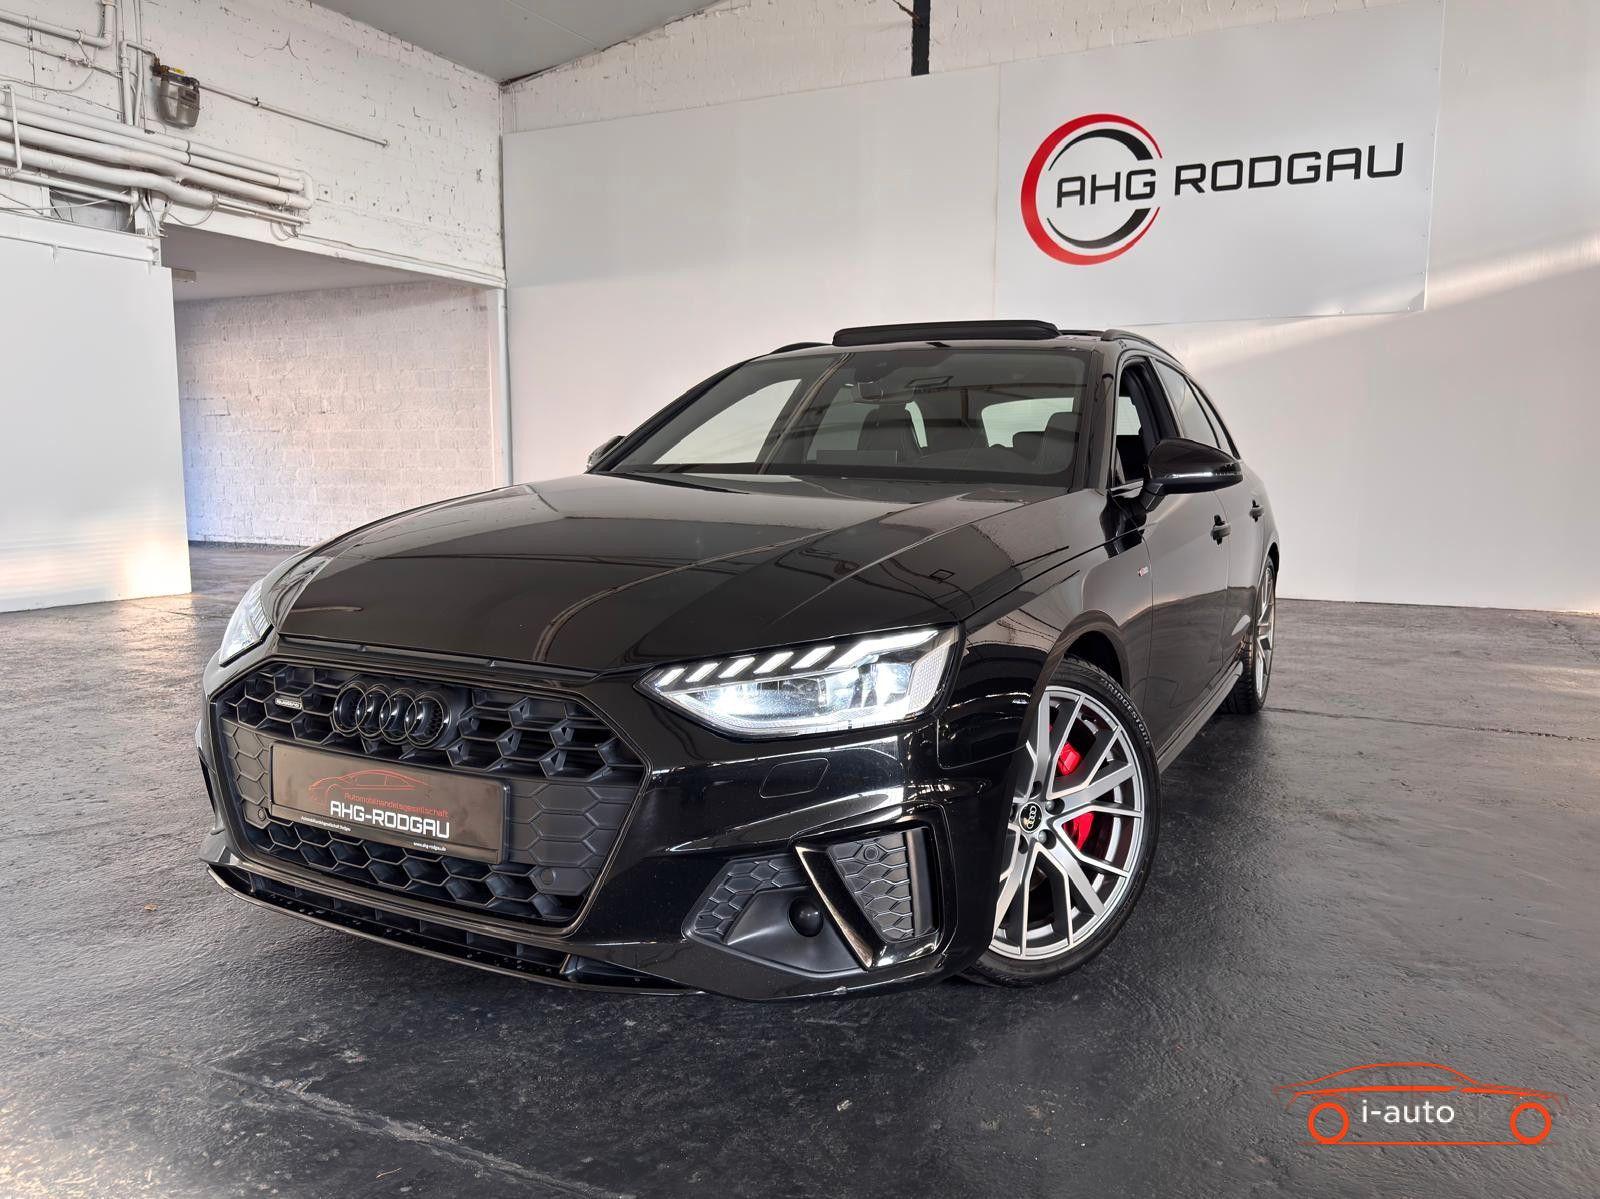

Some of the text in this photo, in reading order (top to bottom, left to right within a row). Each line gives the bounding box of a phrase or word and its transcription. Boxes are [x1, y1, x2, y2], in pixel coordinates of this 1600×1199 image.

[1057, 142, 1404, 209] AHG RODGAU
[330, 800, 450, 839] AHG-RODGAU
